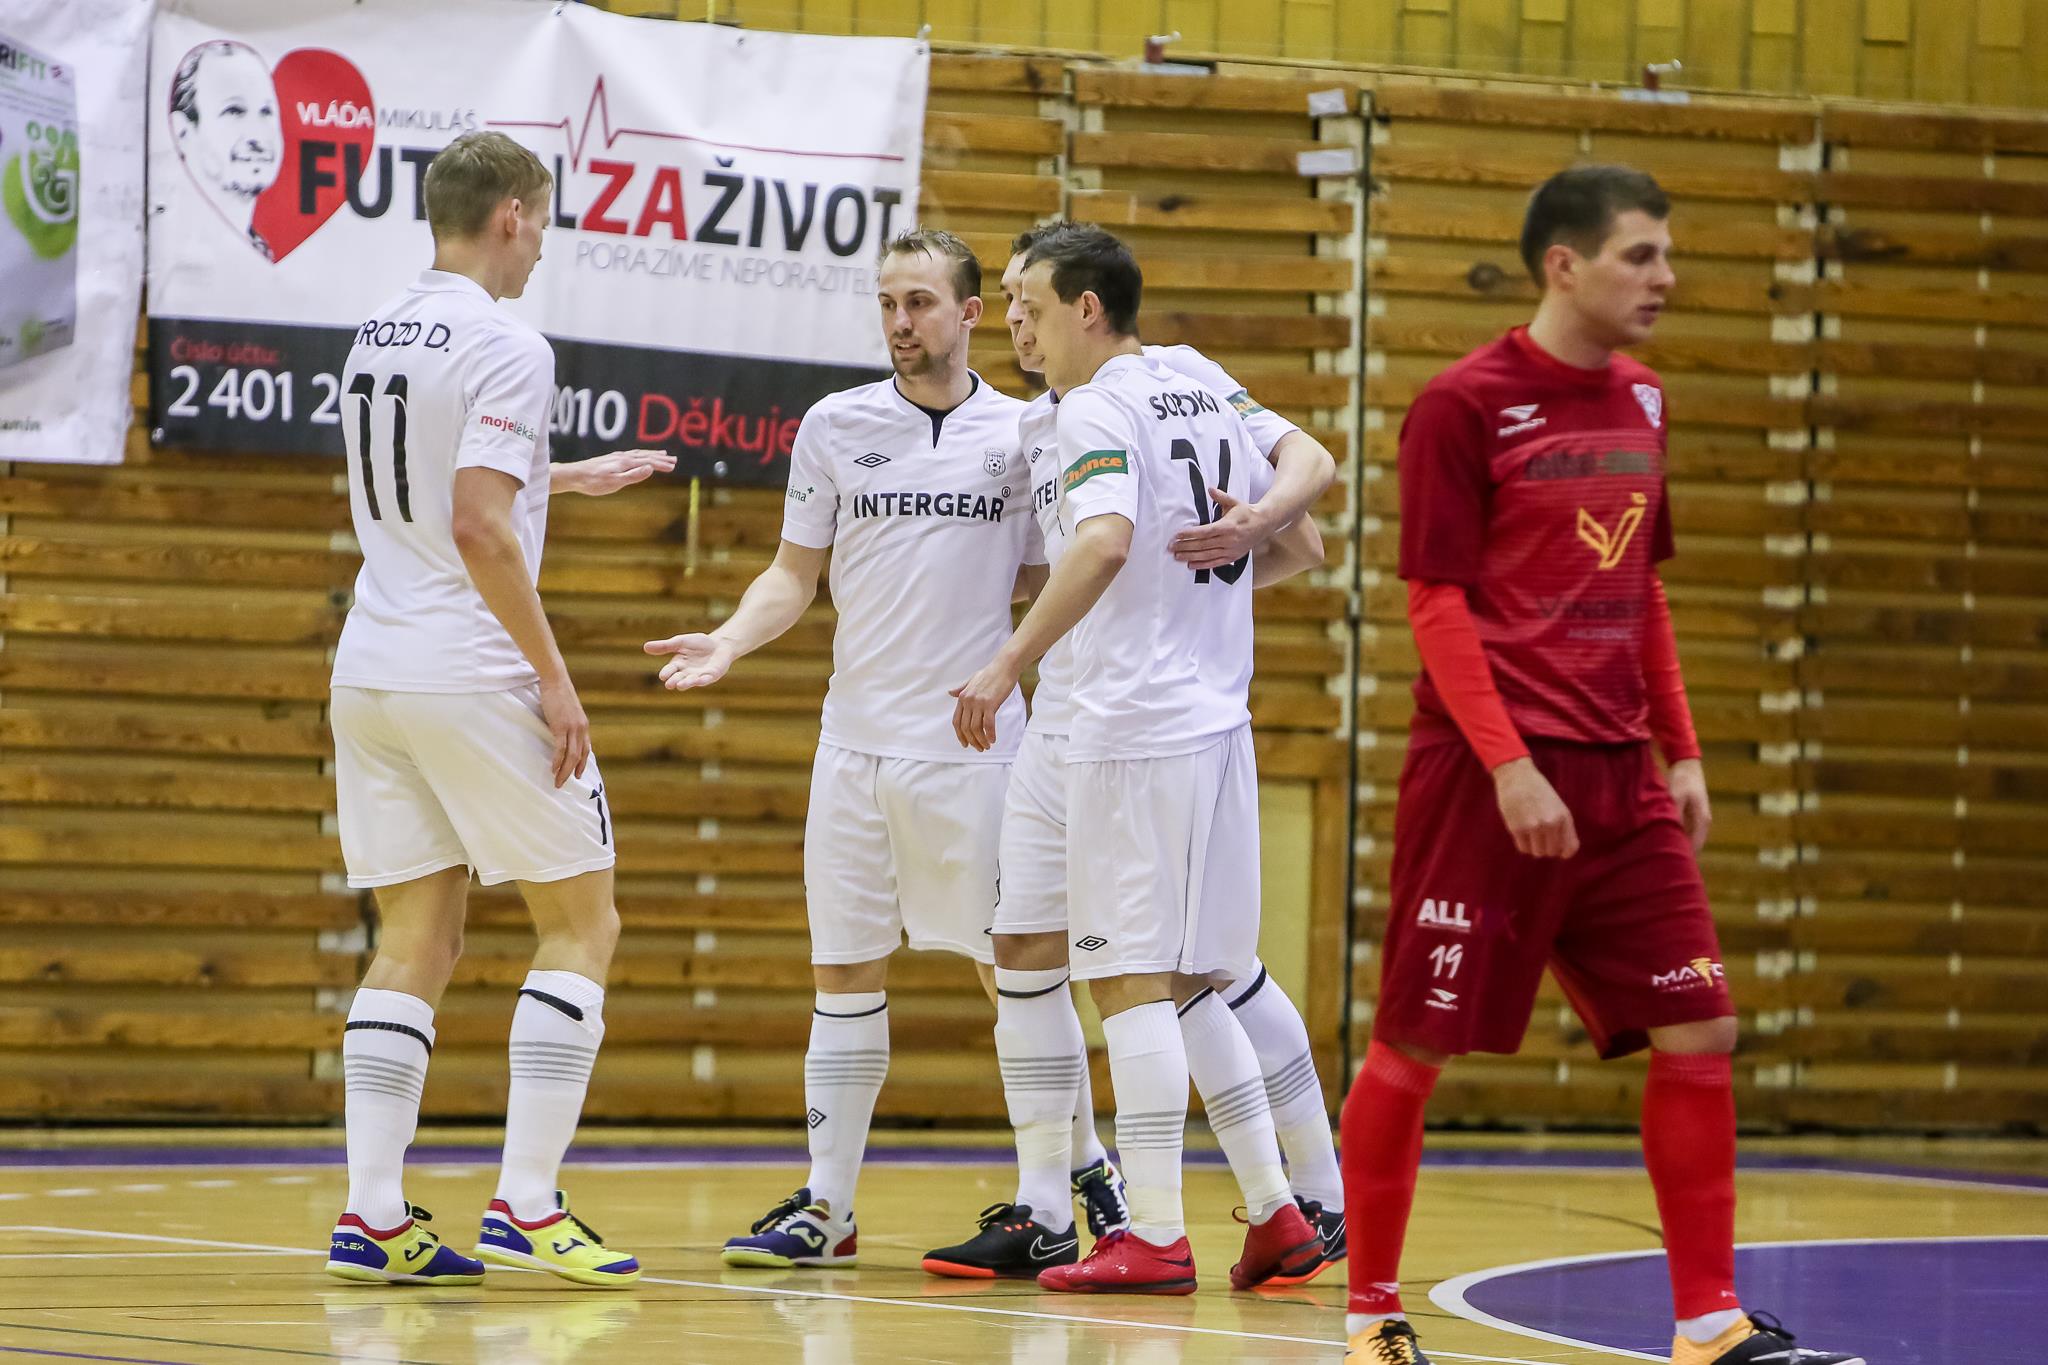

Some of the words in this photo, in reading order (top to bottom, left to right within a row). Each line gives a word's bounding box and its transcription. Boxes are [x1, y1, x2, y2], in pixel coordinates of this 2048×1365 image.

[348, 373, 413, 522] 11
[636, 393, 801, 465] Děkuje
[1417, 898, 1472, 928] ALL
[1428, 943, 1464, 979] 19
